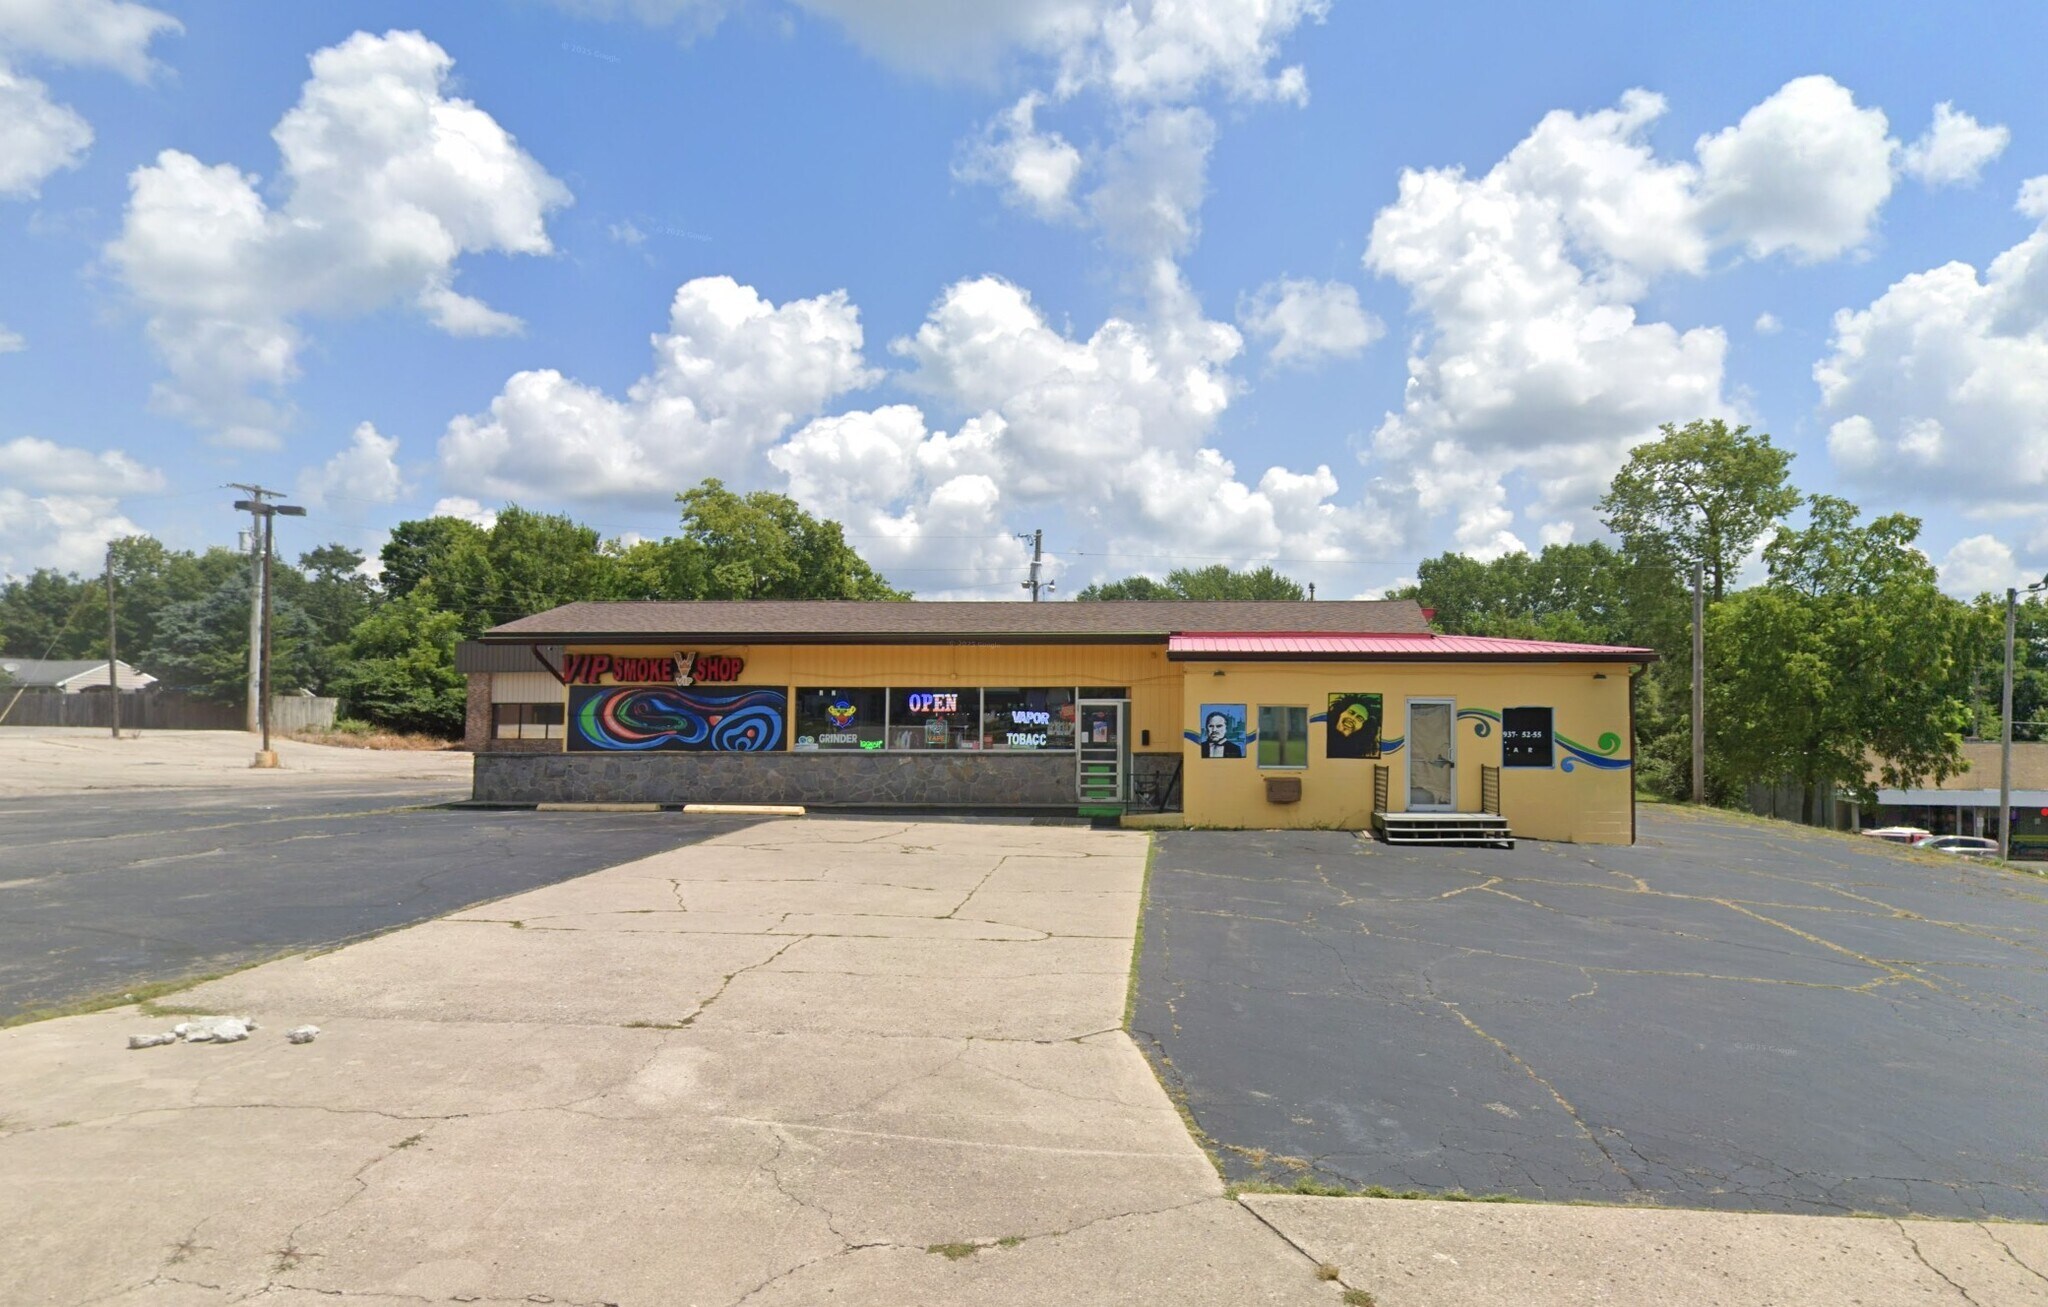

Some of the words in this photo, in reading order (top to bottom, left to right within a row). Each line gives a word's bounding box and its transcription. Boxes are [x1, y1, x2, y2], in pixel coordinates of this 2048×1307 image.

[563, 654, 611, 684] VIP
[613, 658, 672, 682] SMOKE
[695, 657, 744, 682] SHOP
[675, 677, 694, 686] VIP
[908, 693, 958, 712] OPEN
[1012, 711, 1050, 724] VAPOR
[818, 733, 858, 744] GRINDER
[1006, 732, 1047, 746] TOBACC
